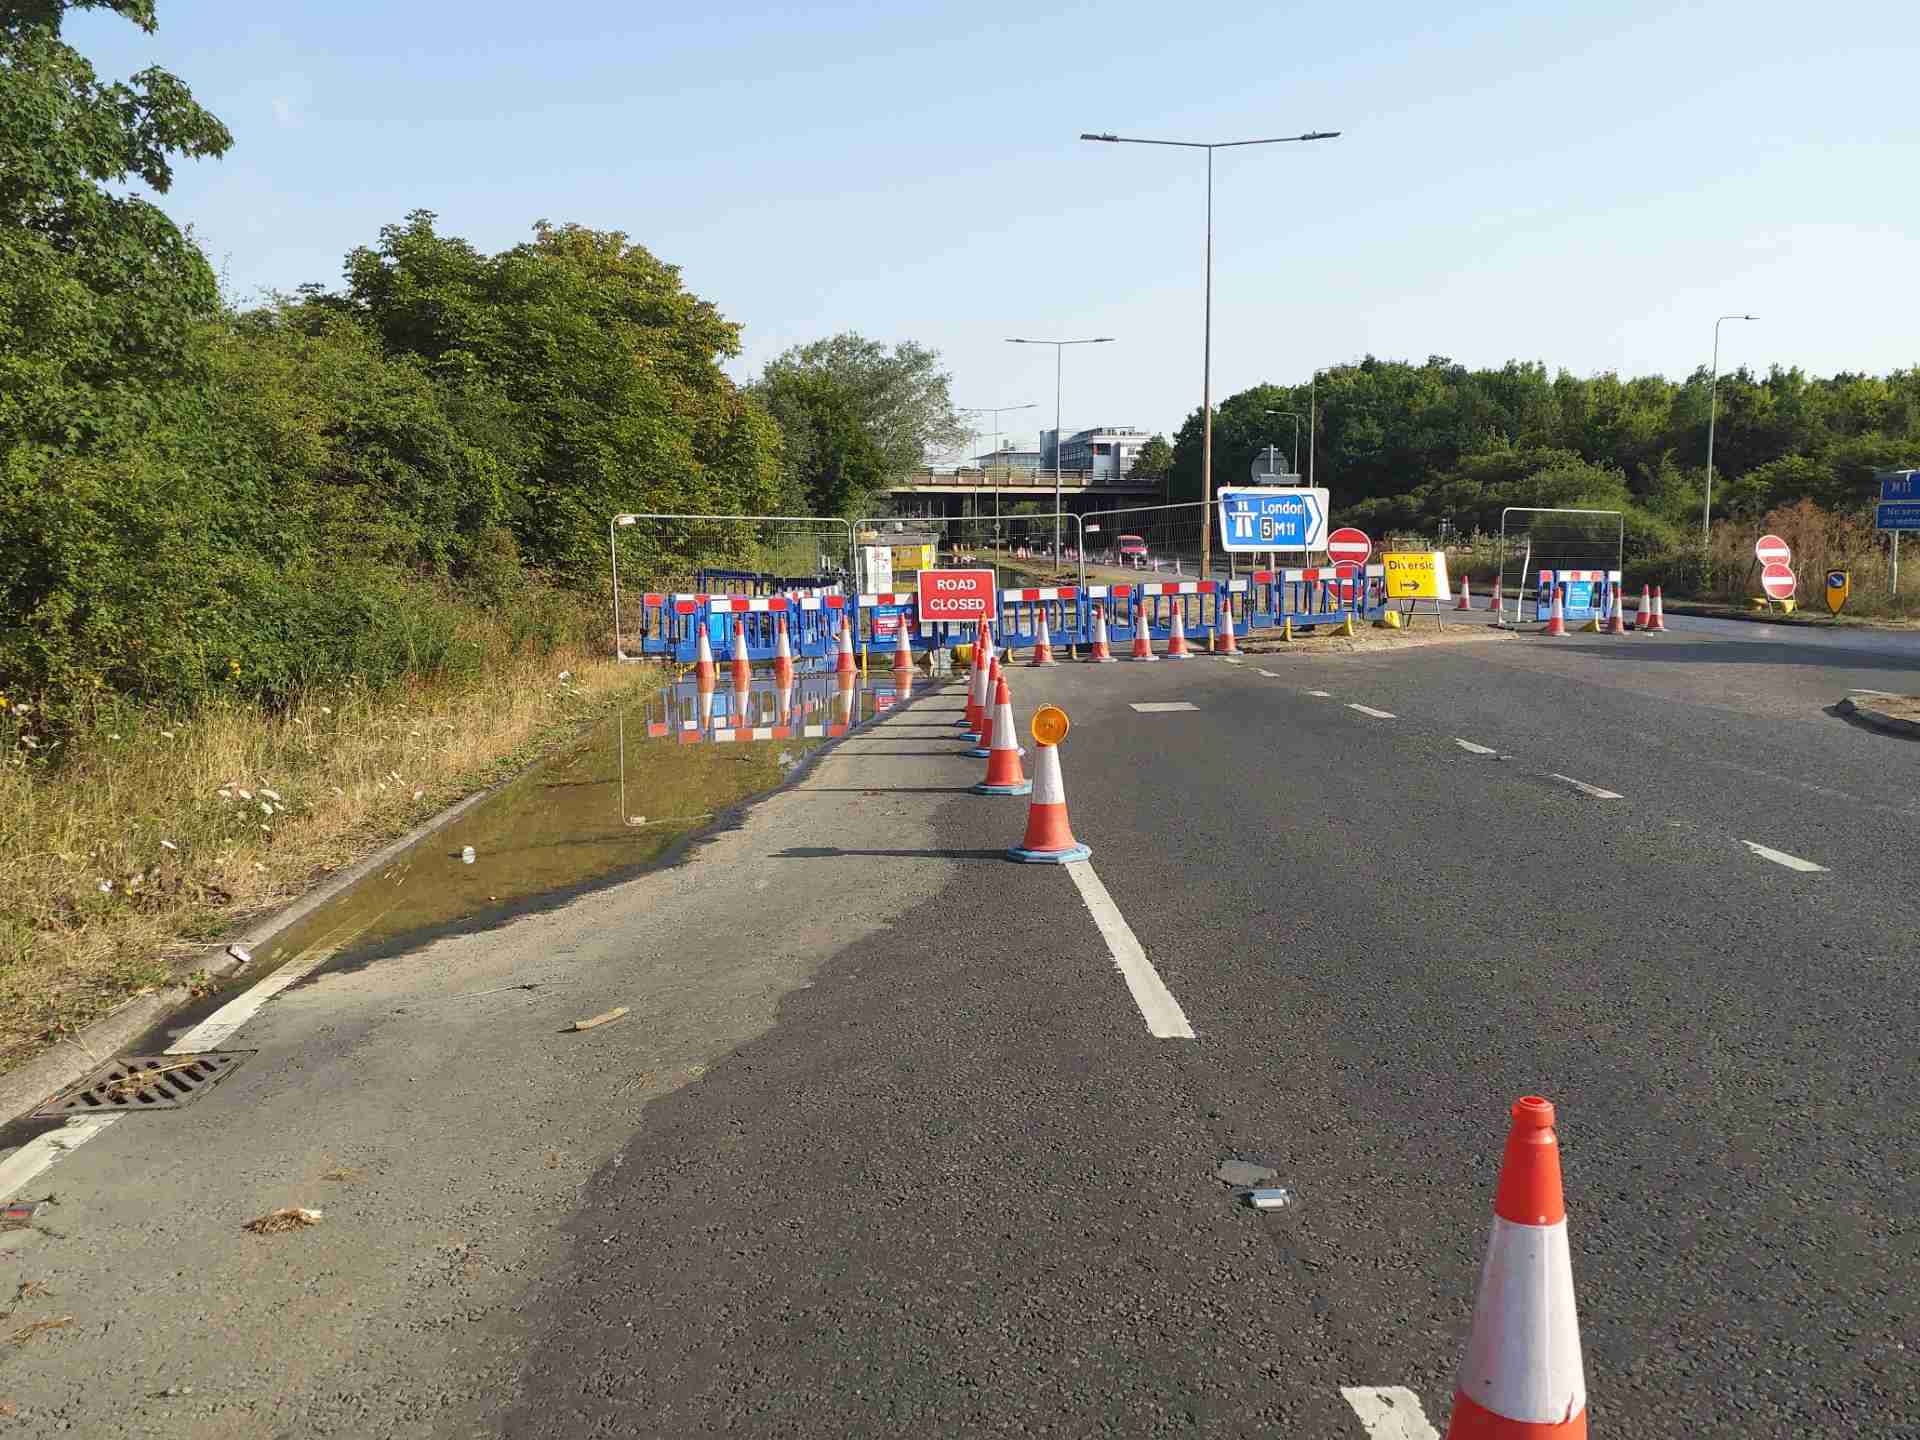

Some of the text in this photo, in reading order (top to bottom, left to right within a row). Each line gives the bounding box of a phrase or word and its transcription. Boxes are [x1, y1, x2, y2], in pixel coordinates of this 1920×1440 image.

[1261, 500, 1304, 514] London
[1275, 522, 1296, 536] M11
[1388, 559, 1437, 571] Diversio
[936, 579, 977, 591] ROAD
[930, 598, 985, 610] CLOSED
